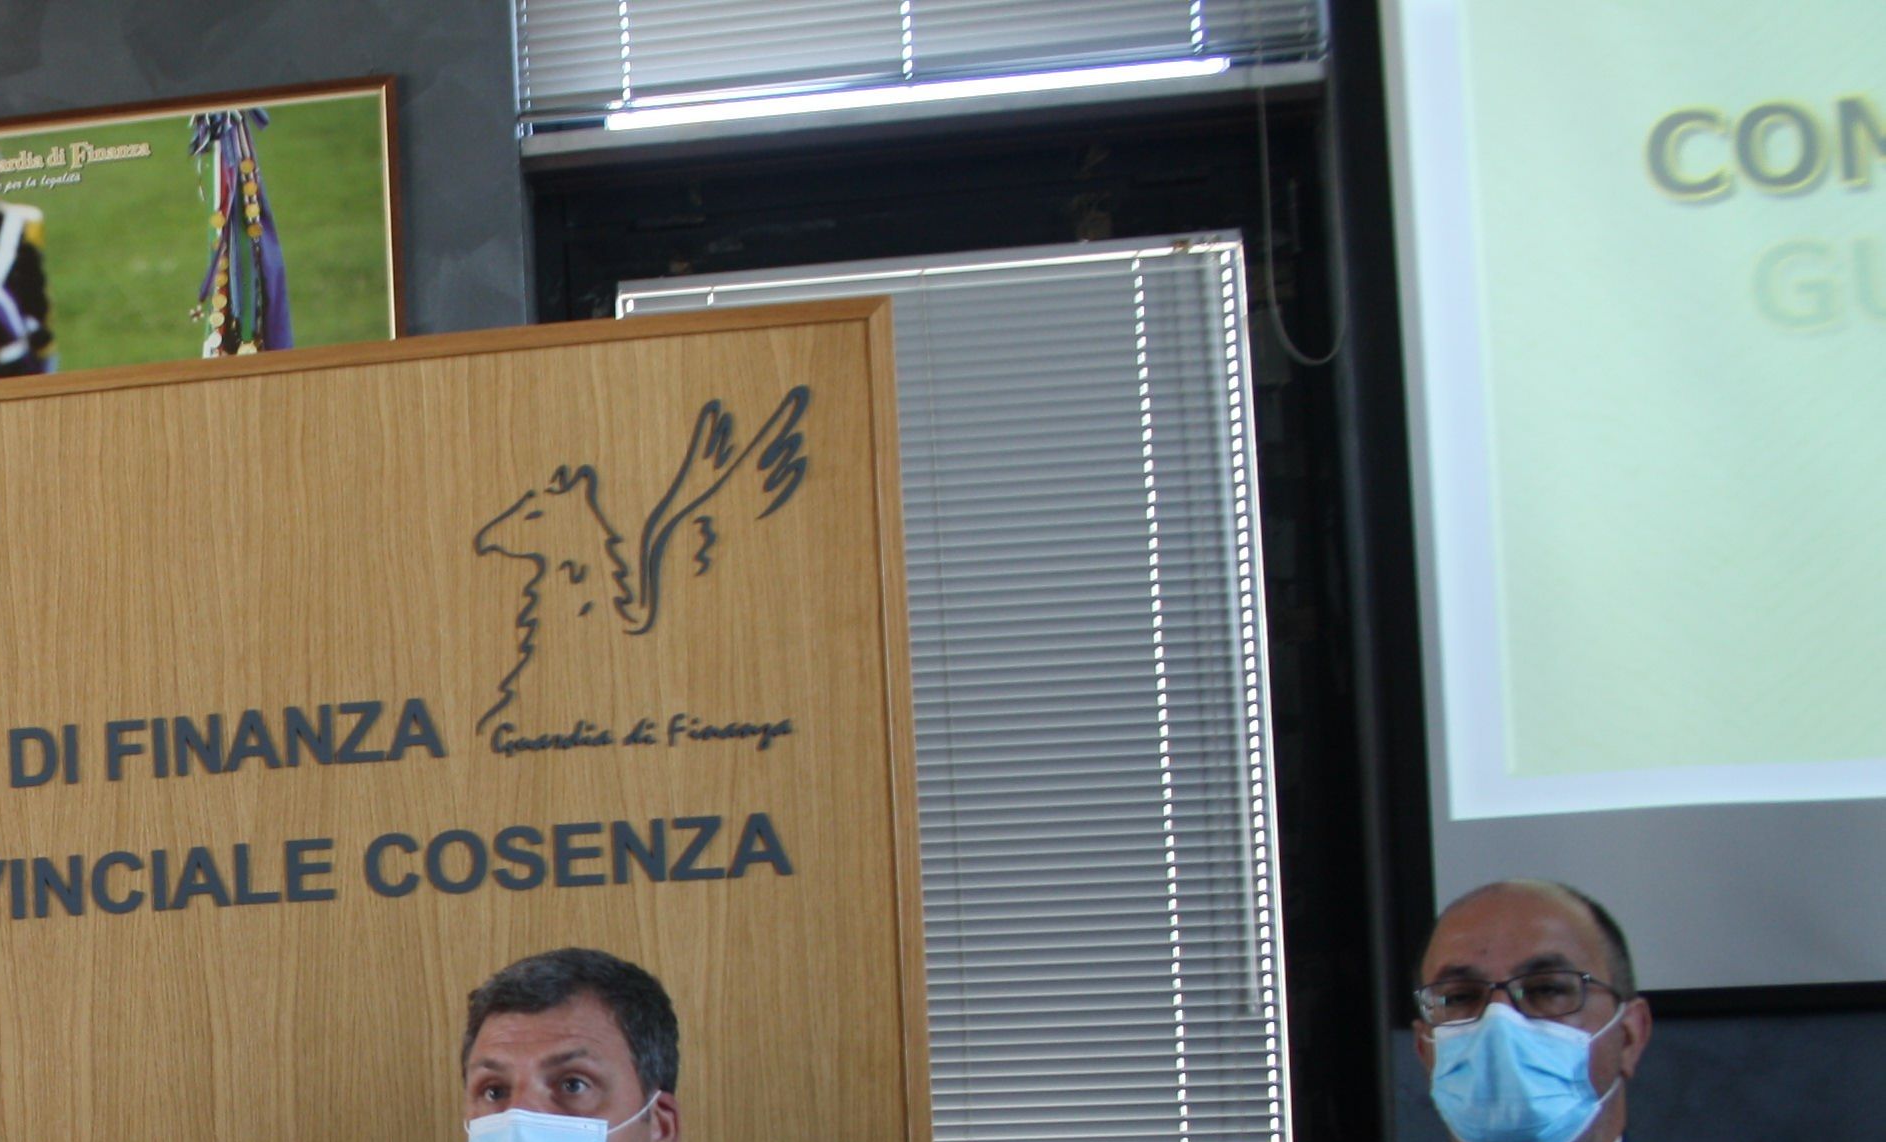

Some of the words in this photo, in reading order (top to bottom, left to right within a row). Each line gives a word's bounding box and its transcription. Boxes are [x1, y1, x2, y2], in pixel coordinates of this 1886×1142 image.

[46, 145, 67, 167] di
[69, 140, 152, 170] Finanza
[3, 181, 22, 194] per
[25, 176, 37, 188] la
[9, 724, 79, 788] DI
[106, 698, 446, 781] FINANZA
[491, 719, 614, 757] Guardia
[623, 718, 658, 747] di
[365, 812, 794, 898] COSENZA
